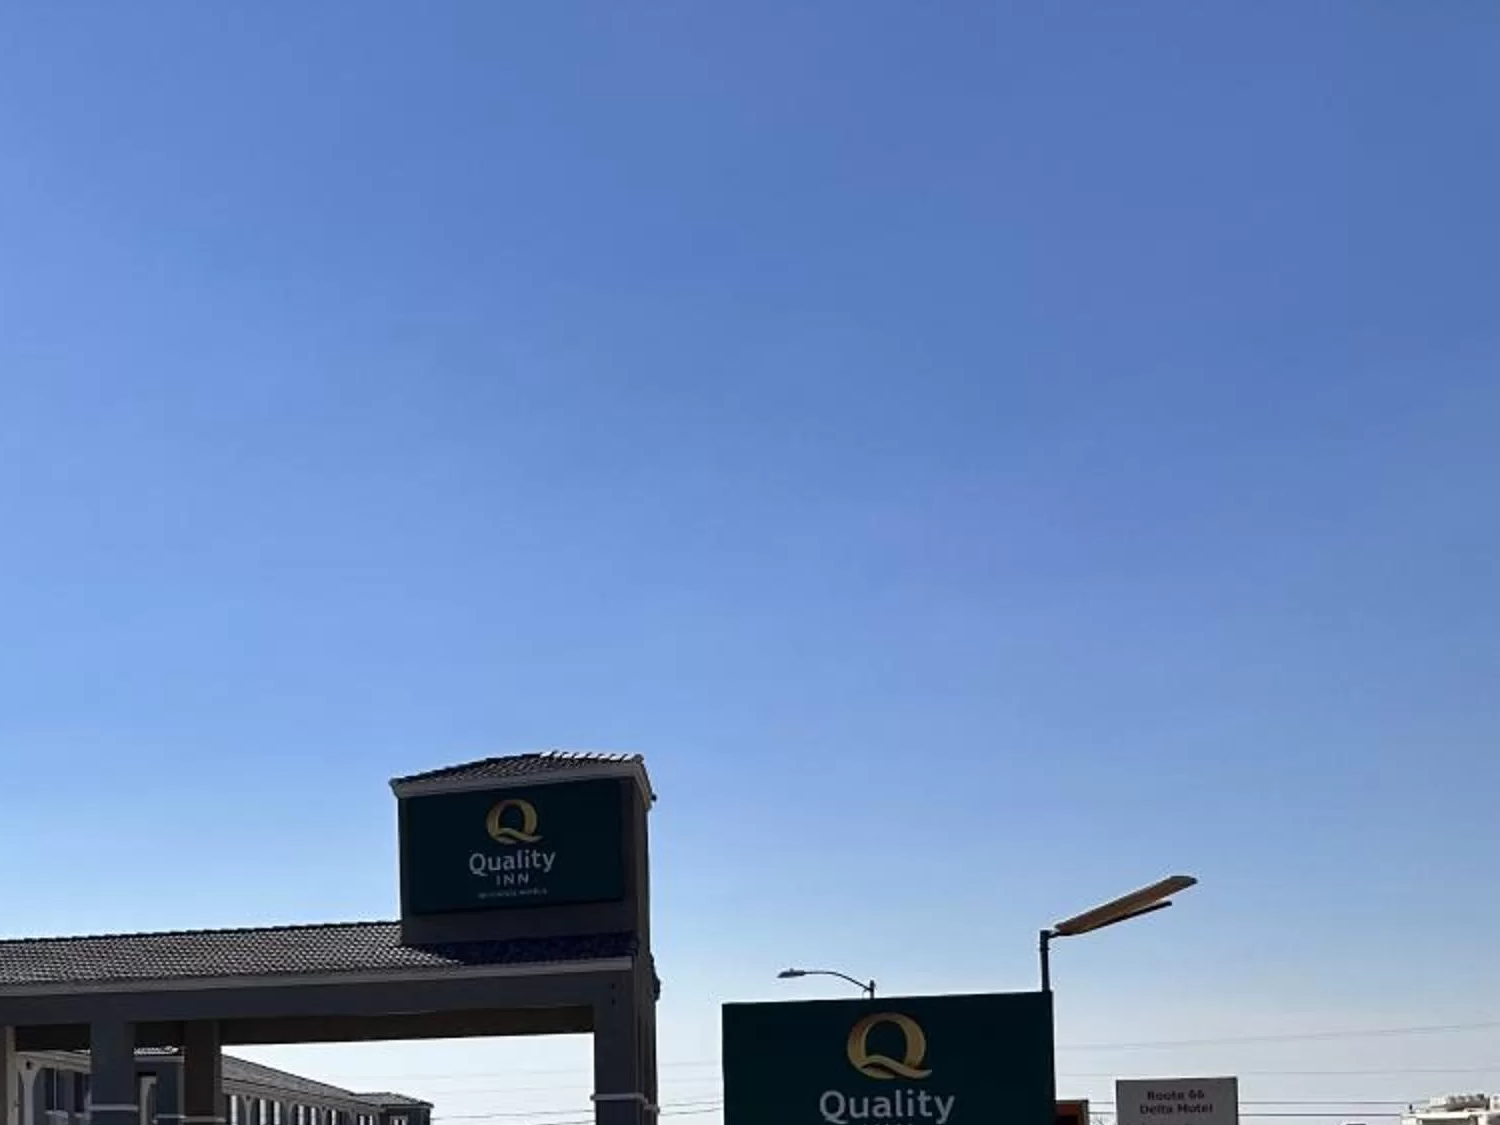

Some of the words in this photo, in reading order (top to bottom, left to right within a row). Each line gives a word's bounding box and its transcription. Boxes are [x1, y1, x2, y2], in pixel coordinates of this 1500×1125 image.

[485, 799, 544, 844] Q
[468, 849, 556, 877] Quality
[496, 872, 530, 887] INN
[847, 1011, 933, 1080] Q
[819, 1089, 955, 1125] Quality
[1139, 1103, 1174, 1115] Delta
